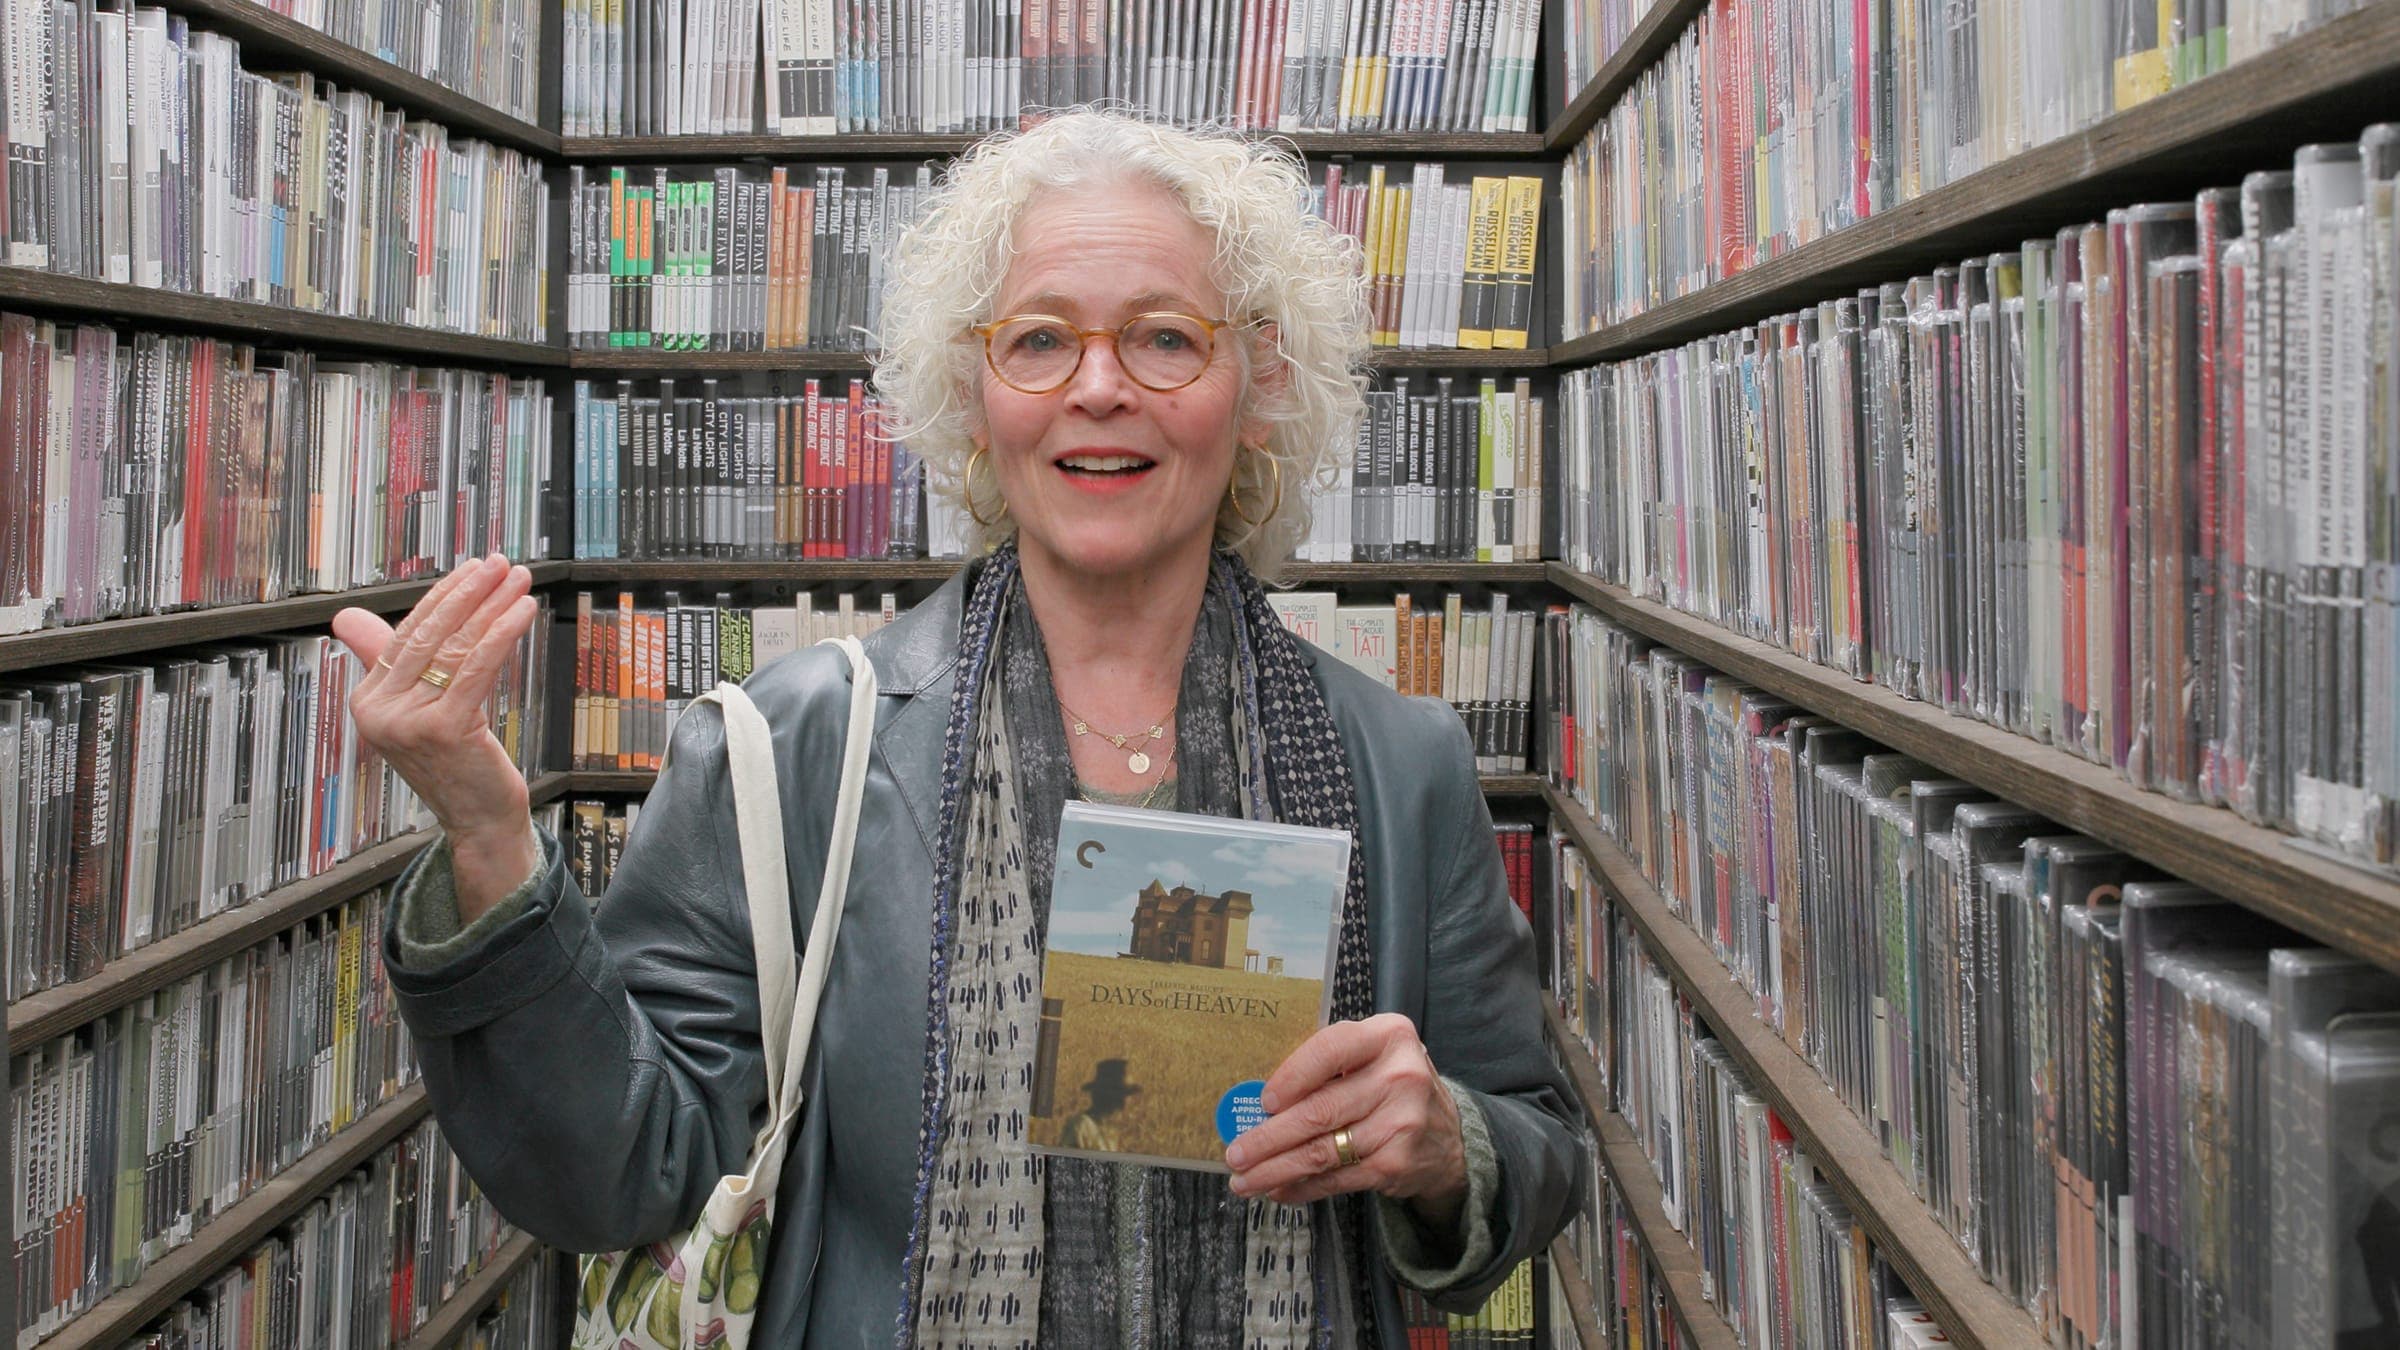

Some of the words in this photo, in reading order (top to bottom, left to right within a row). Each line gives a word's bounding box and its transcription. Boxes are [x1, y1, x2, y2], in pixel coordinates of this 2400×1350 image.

[924, 16, 934, 46] NOON
[938, 22, 948, 52] NOON
[953, 19, 962, 49] NOON
[1030, 6, 1041, 38] TRILOGY
[1058, 12, 1068, 44] TRILOGY
[1086, 12, 1096, 44] TRILOGY
[60, 121, 66, 138] D.
[72, 126, 78, 143] D.
[655, 176, 666, 197] REPO
[718, 179, 729, 223] PIERRE
[736, 185, 748, 229] PIERRE
[754, 185, 768, 229] PIERRE
[716, 227, 727, 265] ETAIX
[735, 233, 747, 271] ETAIX
[753, 234, 766, 271] ETAIX
[1470, 216, 1485, 268] BERGMAN
[1483, 211, 1499, 269] ROSSELLINI
[1505, 216, 1520, 268] BERGMAN
[2266, 276, 2280, 367] HIGH
[619, 393, 628, 406] THE
[706, 402, 715, 427] CITY
[807, 392, 817, 419] TOUKI
[1411, 405, 1419, 422] RIOT
[648, 414, 657, 428] THE
[664, 413, 673, 426] La
[719, 412, 728, 437] CITY
[735, 413, 744, 439] CITY
[821, 408, 829, 436] TOUKI
[835, 409, 845, 436] TOUKI
[1410, 424, 1418, 432] IN
[1426, 408, 1434, 425] RIOT
[1426, 427, 1434, 436] IN
[134, 412, 142, 463] BEAST
[664, 428, 673, 454] Notte
[678, 430, 687, 441] La
[693, 428, 702, 440] La
[705, 431, 714, 467] LIGHTS
[807, 421, 817, 450] BOUKI
[1377, 422, 1391, 475] FRESHMAN
[1410, 434, 1418, 449] CELL
[1426, 437, 1434, 453] CELL
[678, 443, 686, 469] Notte
[693, 441, 702, 468] Notte
[719, 442, 728, 478] LIGHTS
[735, 443, 743, 479] LIGHTS
[821, 439, 830, 466] BOUKI
[835, 439, 845, 467] BOUKI
[1410, 451, 1418, 473] BLOCK
[1425, 455, 1433, 477] BLOCK
[2320, 516, 2330, 558] MAN
[593, 624, 602, 649] RED
[607, 626, 617, 651] RED
[620, 602, 632, 668] JUDEX
[667, 614, 677, 636] HARD
[682, 621, 692, 643] HARD
[702, 623, 711, 644] HARD
[1283, 612, 1319, 643] TATI
[636, 622, 648, 688] JUDEX
[667, 638, 677, 661] DAY'S
[721, 607, 729, 675] SCANNERS
[731, 617, 739, 680] SCANNERS
[743, 617, 751, 677] SCANNERS
[1349, 626, 1385, 657] TATI
[592, 652, 602, 691] RIVER
[651, 626, 662, 692] JUDEX
[682, 645, 692, 668] DAY'S
[702, 646, 711, 669] DAY'S
[606, 654, 617, 692] RIVER
[668, 662, 677, 687] NIGHT
[683, 669, 692, 694] NIGHT
[103, 694, 113, 739] MR.
[93, 730, 103, 804] CONFIDENTIAL
[97, 741, 111, 845] ARKADIN
[581, 816, 593, 836] LES
[1090, 984, 1153, 1008] DAYS
[1154, 993, 1170, 1009] of
[1172, 991, 1280, 1019] HEAVEN
[157, 1061, 165, 1127] ORGANISM
[168, 1053, 176, 1118] ORGANISM
[1233, 1096, 1261, 1105] DIREC
[31, 1063, 40, 1139] BRUTE
[50, 1084, 59, 1144] BRUTE
[1231, 1105, 1263, 1114] APPRO
[40, 1094, 48, 1156] BRUTE
[1235, 1115, 1268, 1123] BLU-R
[27, 1146, 37, 1223] FORCE
[37, 1161, 47, 1223] FORCE
[49, 1150, 57, 1210] FORCE
